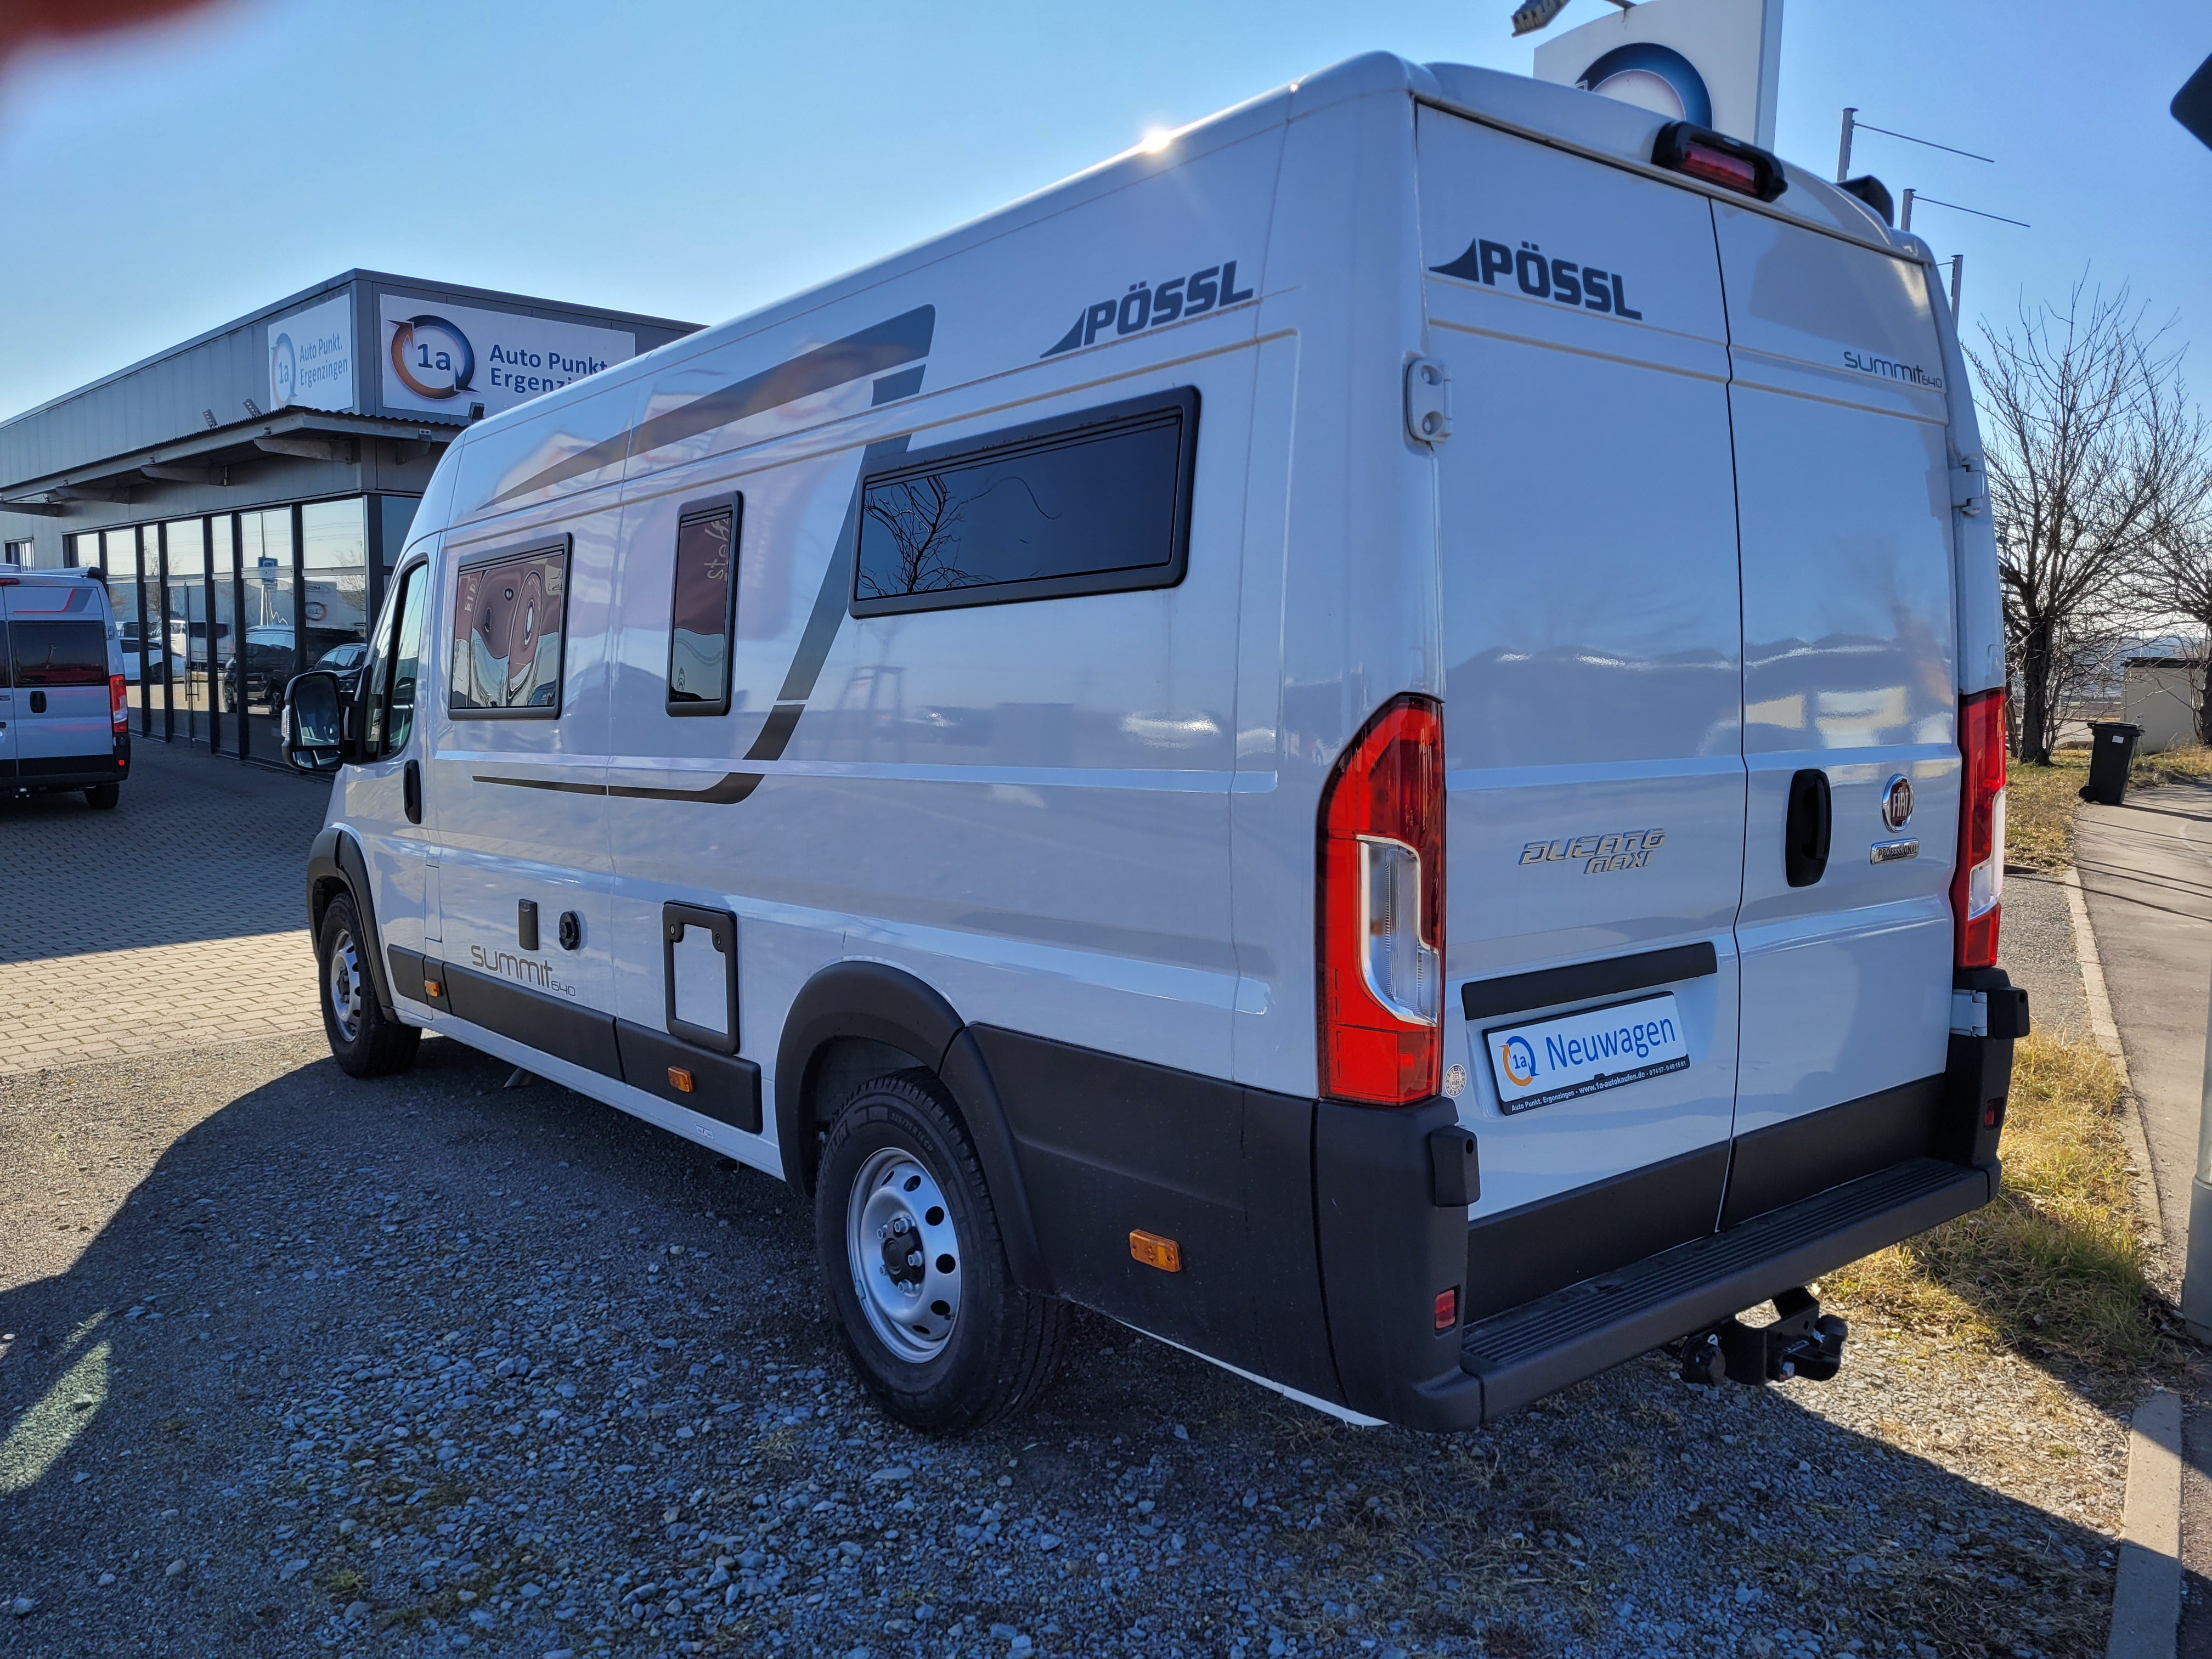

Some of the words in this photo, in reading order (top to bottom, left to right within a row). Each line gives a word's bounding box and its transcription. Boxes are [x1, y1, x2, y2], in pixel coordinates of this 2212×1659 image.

[1479, 238, 1643, 321] PÖSSL
[1084, 259, 1254, 346] PÖSSL
[300, 343, 317, 363] Auto
[318, 332, 343, 357] Punkt.
[417, 343, 452, 371] 1a
[489, 344, 541, 368] Auto
[279, 361, 289, 384] 1a
[300, 358, 348, 388] Ergenzingen
[1921, 375, 1943, 388] 640
[1892, 792, 1909, 818] FIAT
[1518, 828, 1667, 865] DUCATO
[1877, 843, 1918, 860] PROFESSIONAL
[1583, 850, 1654, 874] MAXI
[550, 980, 576, 997] 640
[1545, 1018, 1676, 1071] Neuwagen
[1513, 1054, 1528, 1070] 1a
[1511, 1104, 1524, 1112] Auto
[1525, 1098, 1542, 1108] Punkt.
[1543, 1091, 1575, 1103] Ergenzingen
[1578, 1071, 1645, 1094] www.1a-autokaufen.de
